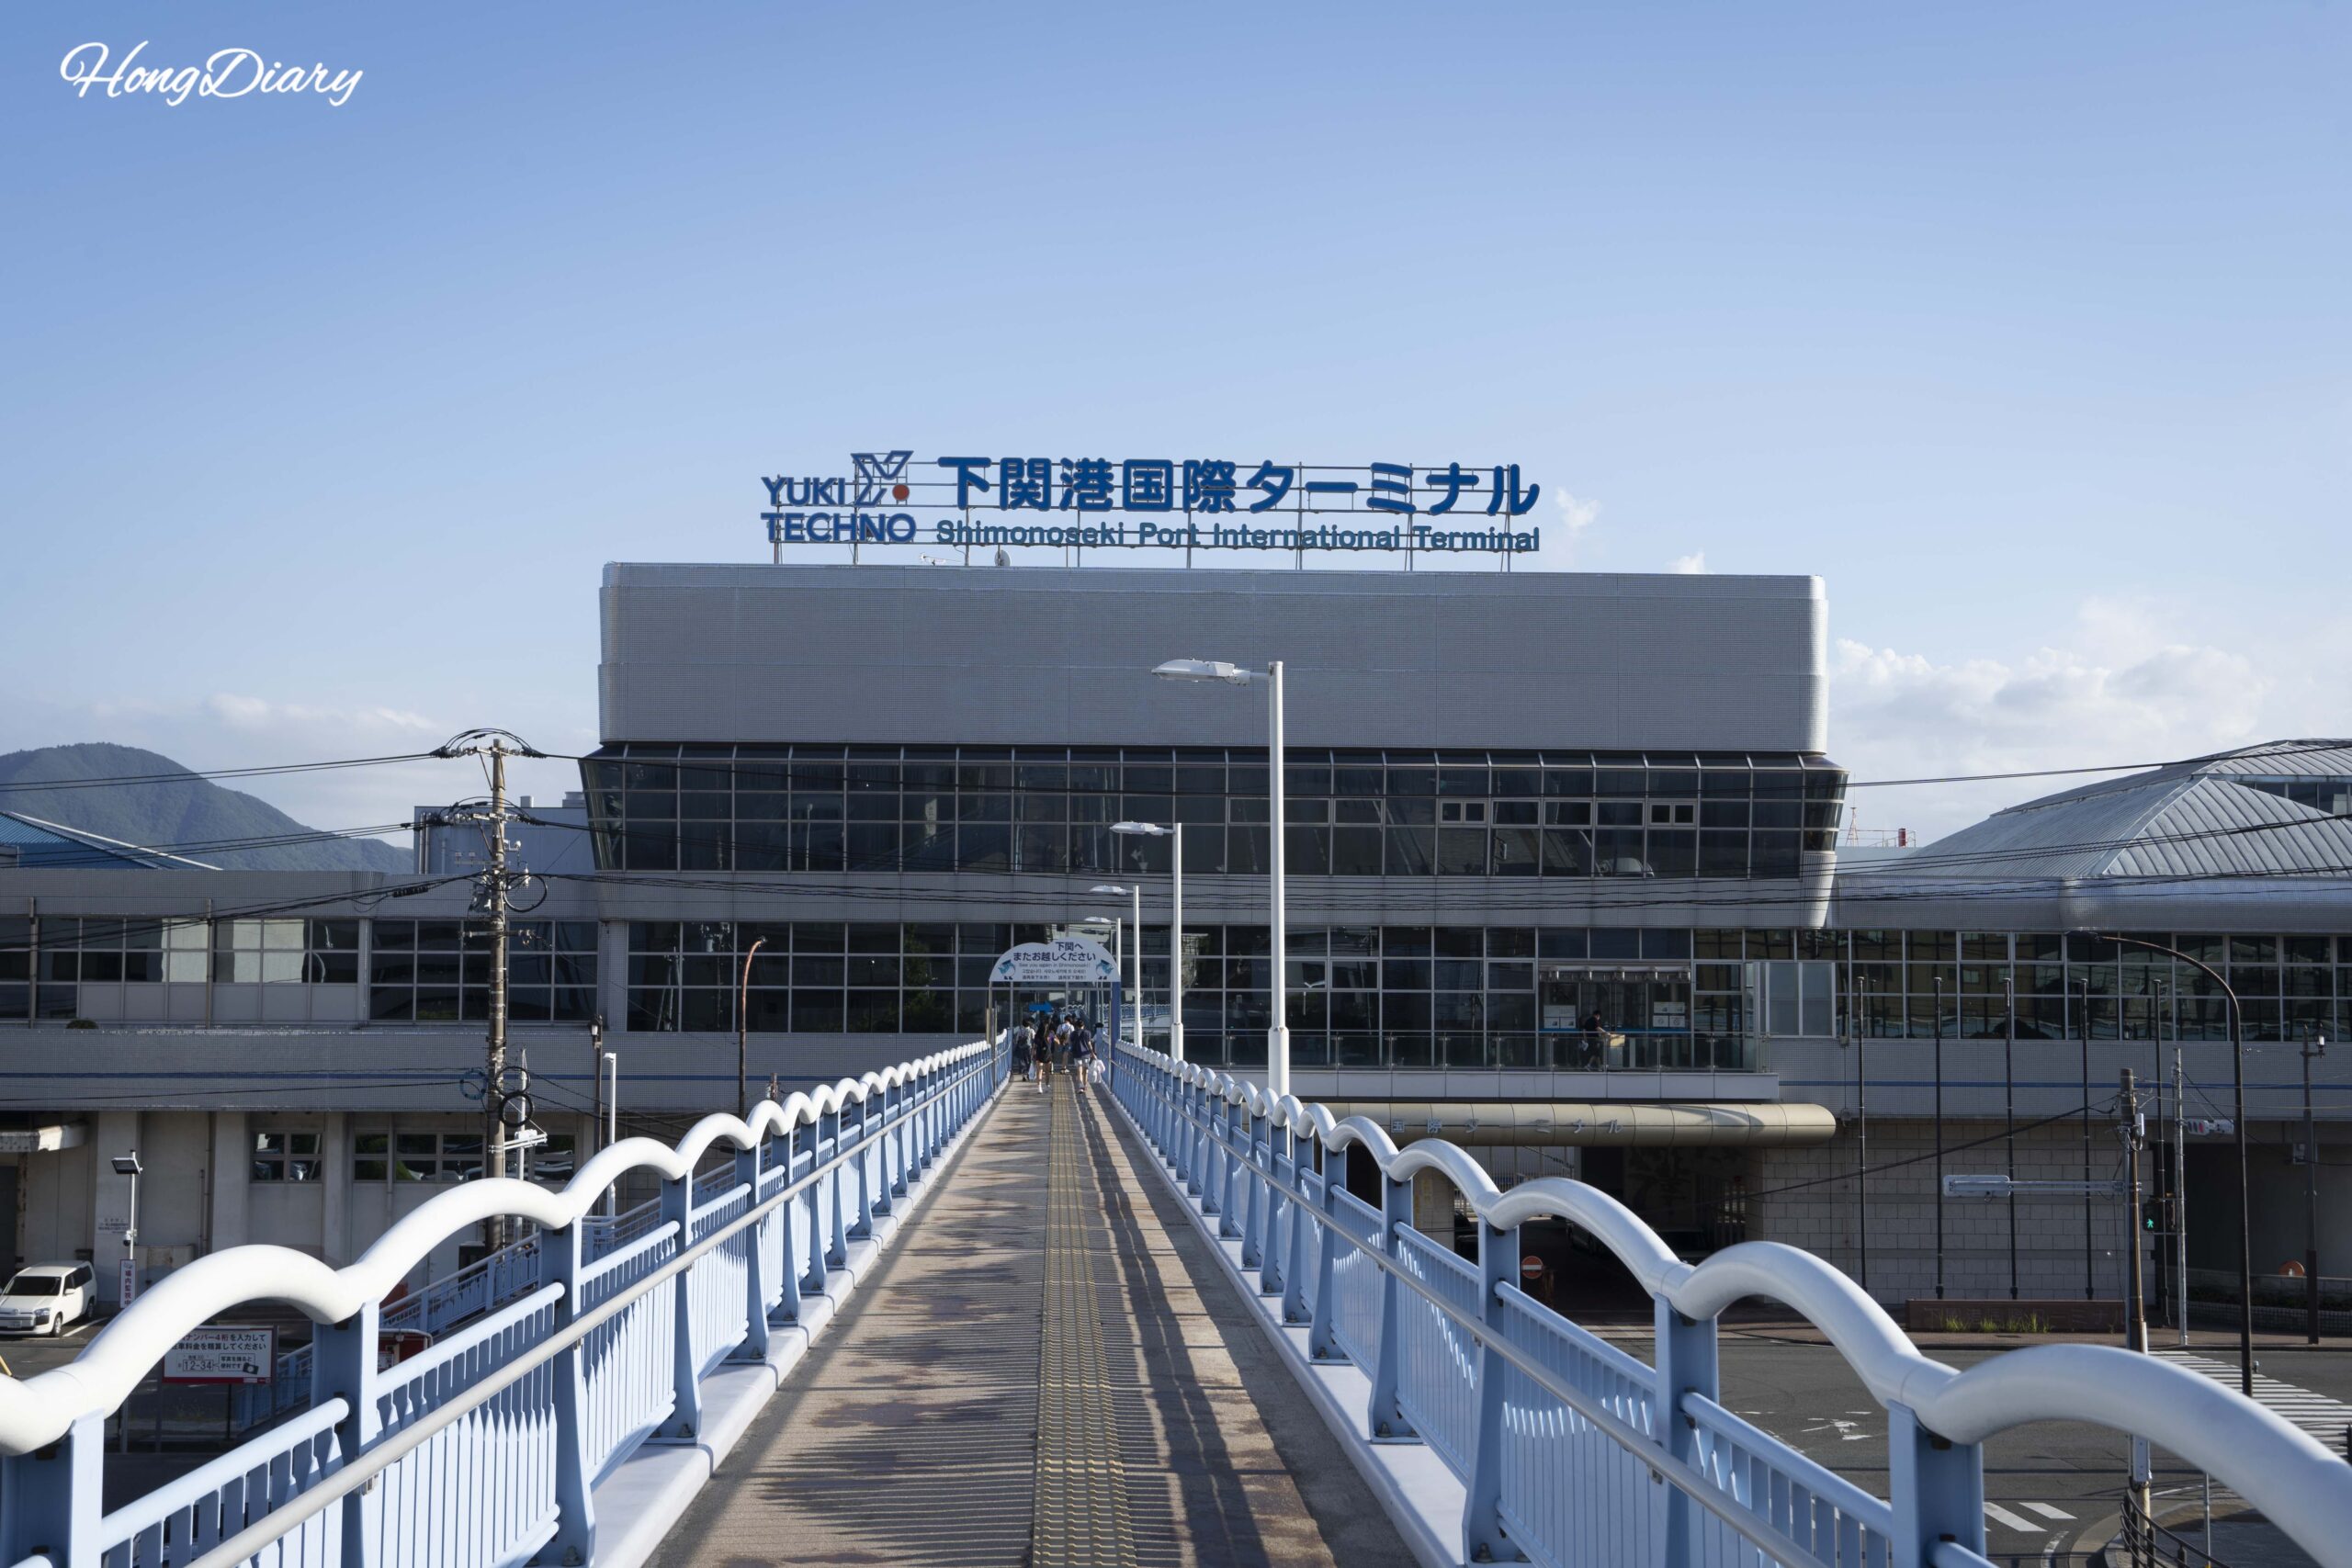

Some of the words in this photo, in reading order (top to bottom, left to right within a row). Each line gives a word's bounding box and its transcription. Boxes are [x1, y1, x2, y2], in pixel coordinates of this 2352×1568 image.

[761, 477, 845, 506] YUKI
[937, 457, 1541, 516] 下関港国際ターミナル
[761, 513, 917, 543] TECHNO
[936, 520, 1124, 546] Shimonoseki
[1139, 523, 1200, 547] Port
[1214, 523, 1400, 548] International
[1414, 525, 1540, 551] Terminal
[1013, 952, 1096, 962] またお越しください
[1055, 942, 1083, 952] 下関へ
[181, 1333, 266, 1342] ナンバー4桁を入力して
[184, 1360, 212, 1371] 12-34
